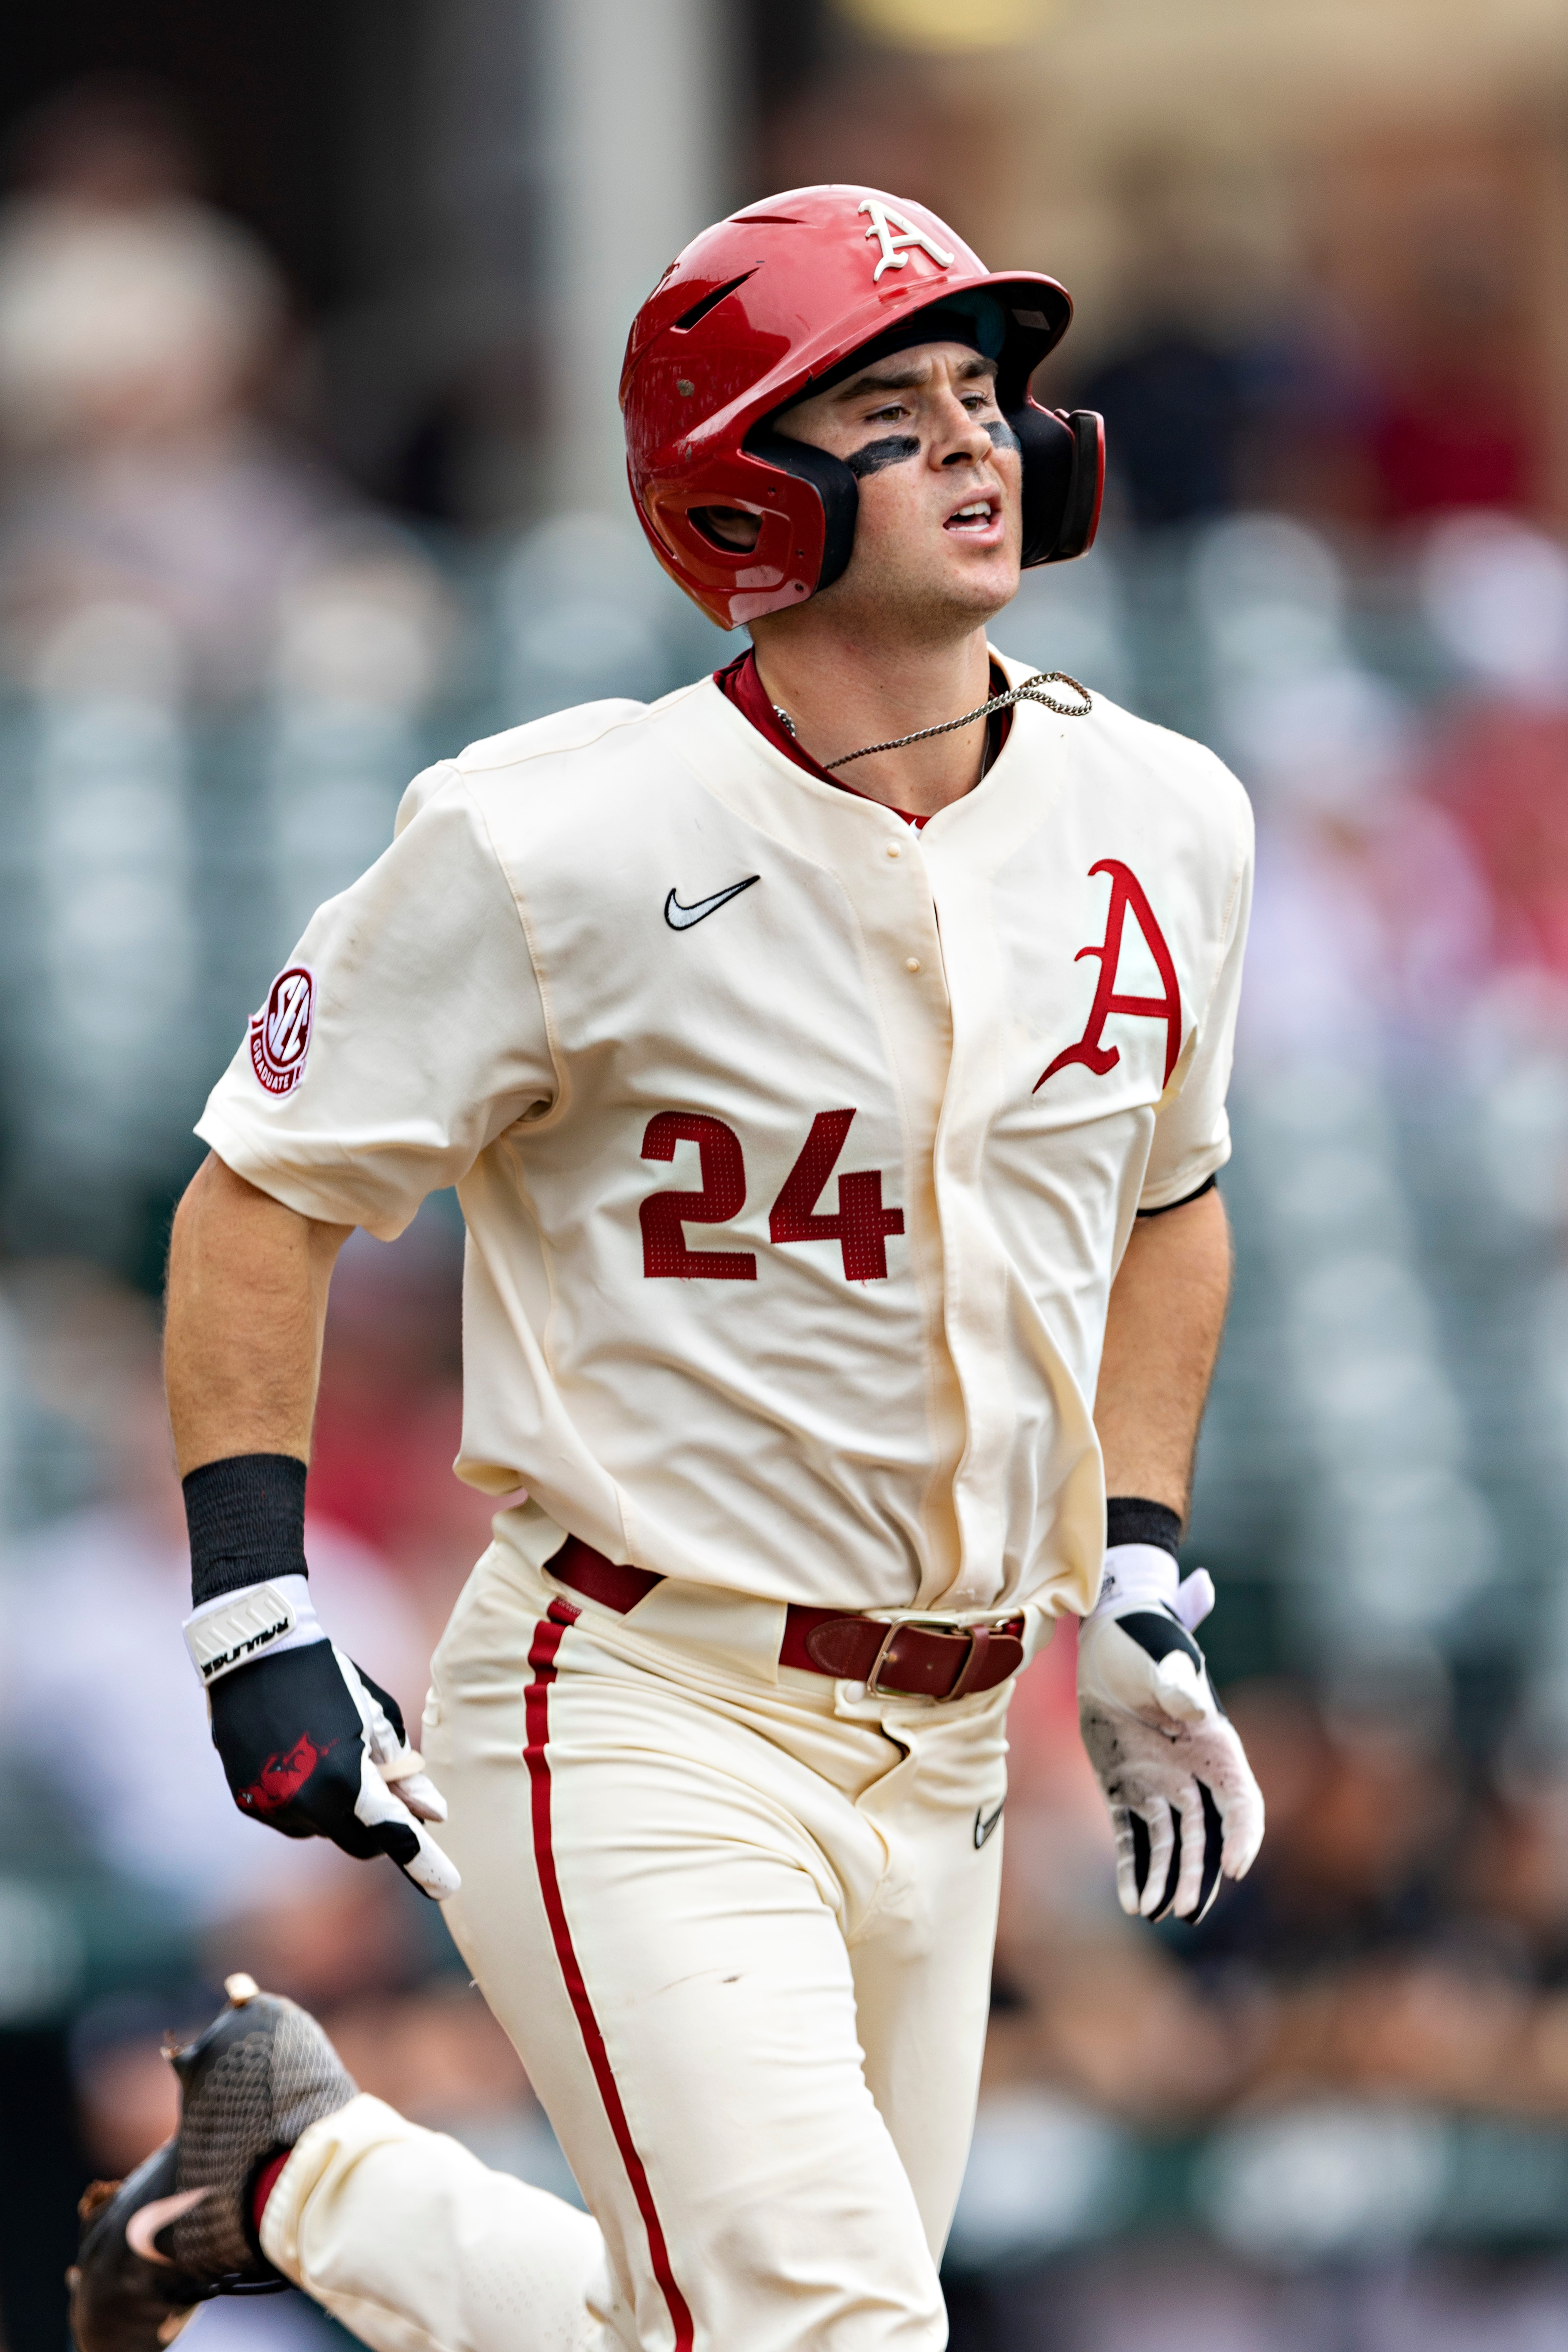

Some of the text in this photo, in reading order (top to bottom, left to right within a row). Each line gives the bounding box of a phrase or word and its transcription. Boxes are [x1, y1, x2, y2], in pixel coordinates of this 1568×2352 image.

[857, 199, 955, 282] A
[268, 974, 310, 1061] SEC
[1032, 858, 1182, 1094] A
[253, 1038, 290, 1090] GRADUATE
[639, 1108, 905, 1281] 24
[201, 1616, 289, 1678] RAWLINGS
